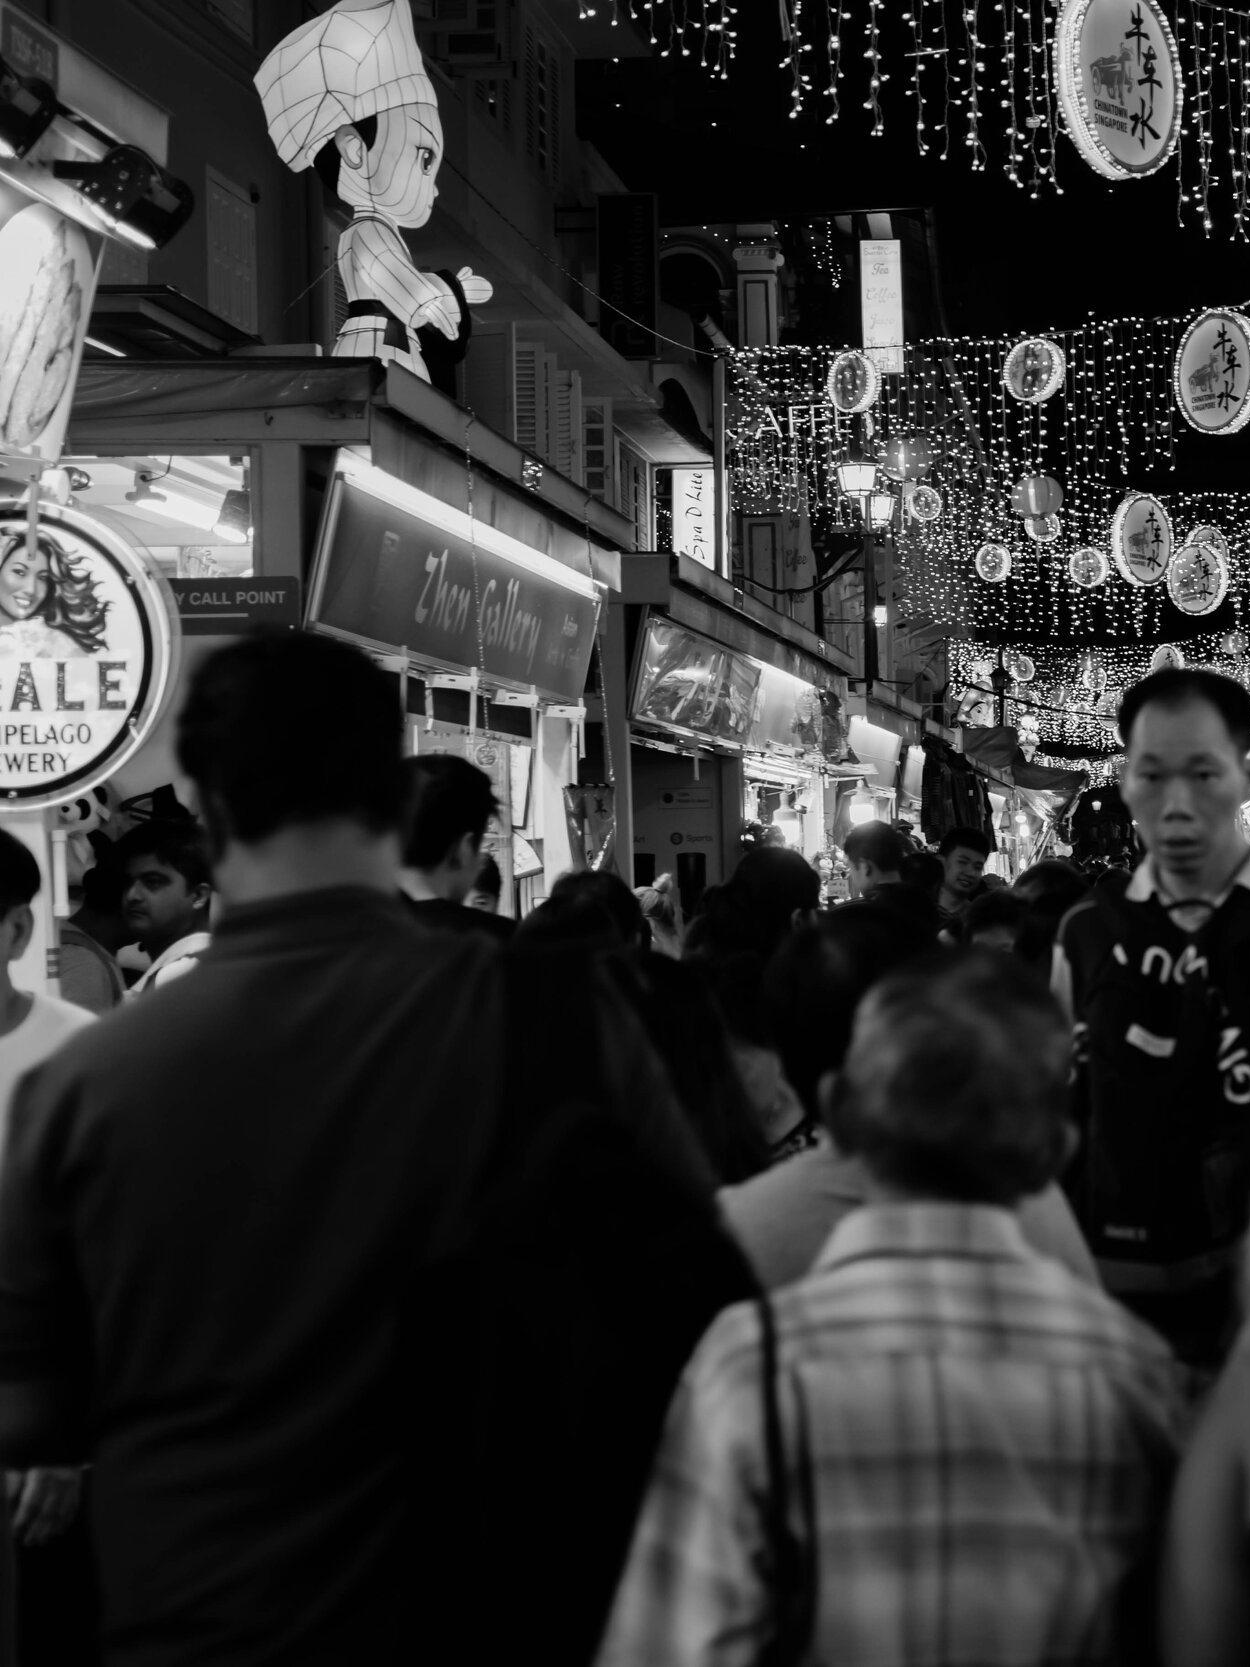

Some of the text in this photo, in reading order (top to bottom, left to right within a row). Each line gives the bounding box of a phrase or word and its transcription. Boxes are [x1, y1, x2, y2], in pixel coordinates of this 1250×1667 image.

[1094, 99, 1128, 118] CHINATOWN
[1094, 113, 1128, 133] SINGAPORE
[189, 591, 231, 605] CALL
[236, 590, 286, 605] POINT
[479, 578, 543, 676] Gallery
